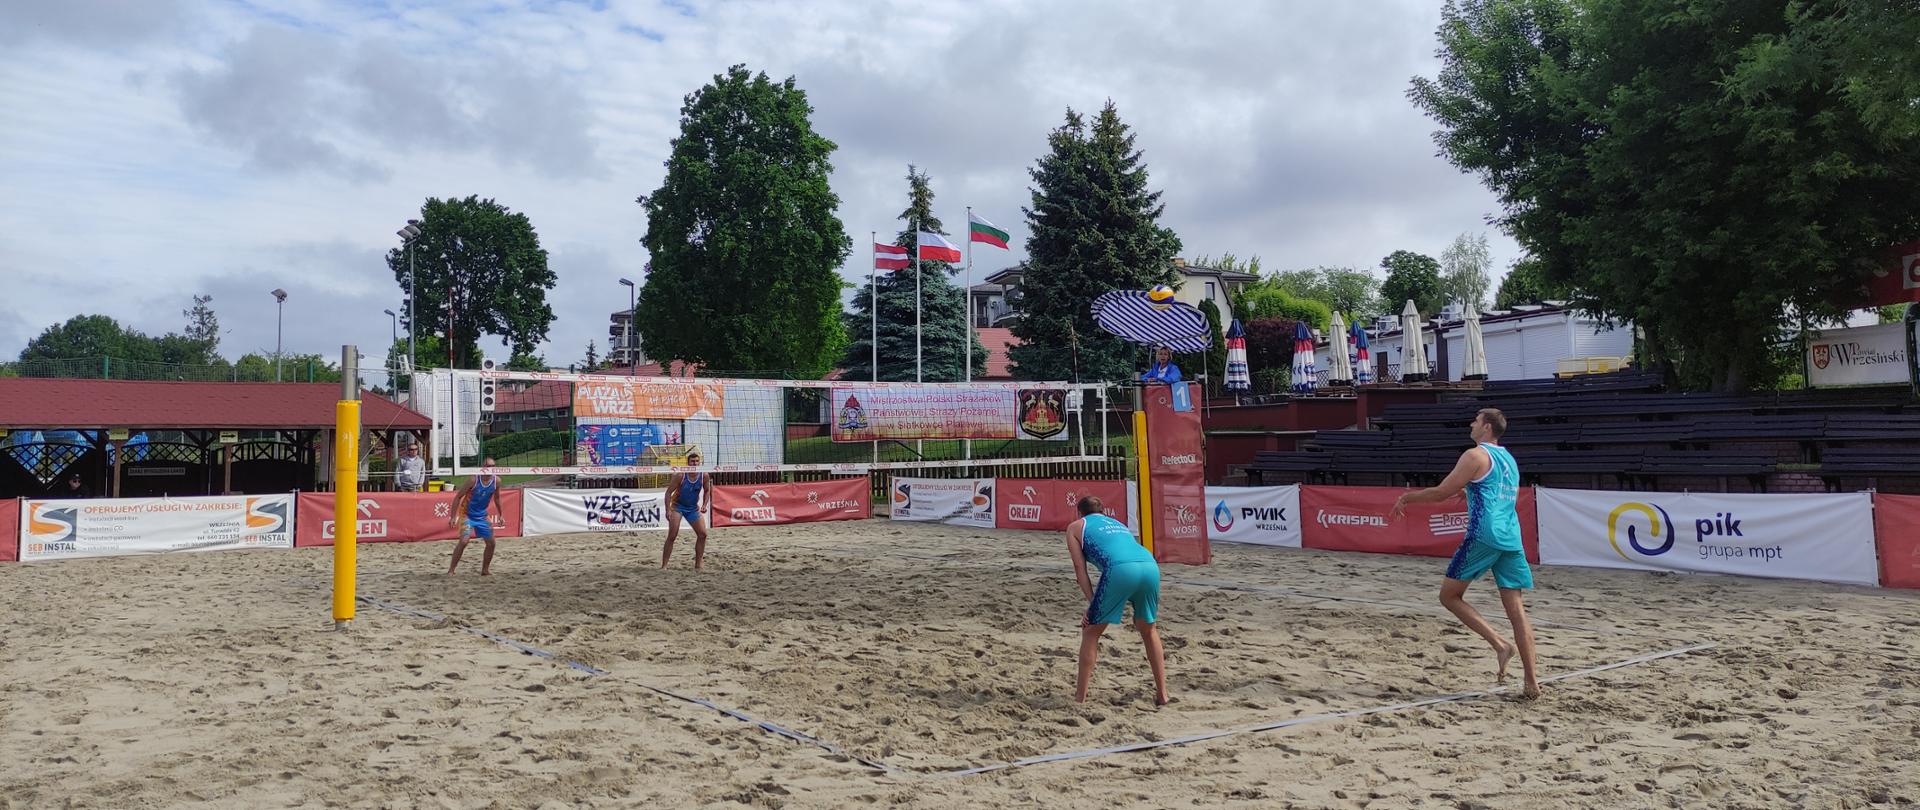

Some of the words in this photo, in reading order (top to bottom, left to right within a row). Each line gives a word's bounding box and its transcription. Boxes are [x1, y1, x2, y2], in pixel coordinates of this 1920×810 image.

[926, 395, 953, 403] Polski
[1177, 386, 1187, 407] 1
[84, 505, 145, 514] OFERUJEMY
[146, 503, 181, 513] USŁUGI
[183, 503, 193, 511] W
[582, 495, 632, 510] WZPS
[818, 500, 859, 510] WRZEŚNIA
[587, 504, 660, 525] POZNAŃ
[734, 508, 772, 519] ORLEN
[1011, 506, 1039, 519] ORLEN
[1241, 507, 1287, 521] PWIK
[1328, 514, 1388, 526] KRISPOL
[326, 522, 383, 536] OEN
[1256, 523, 1288, 531] WRZEŚNIA
[1696, 512, 1743, 542] pik
[259, 534, 287, 542] INSTAL
[27, 543, 43, 551] SEB
[44, 541, 77, 551] INSTAL
[1699, 545, 1743, 560] grupa
[1749, 546, 1783, 562] mpt
